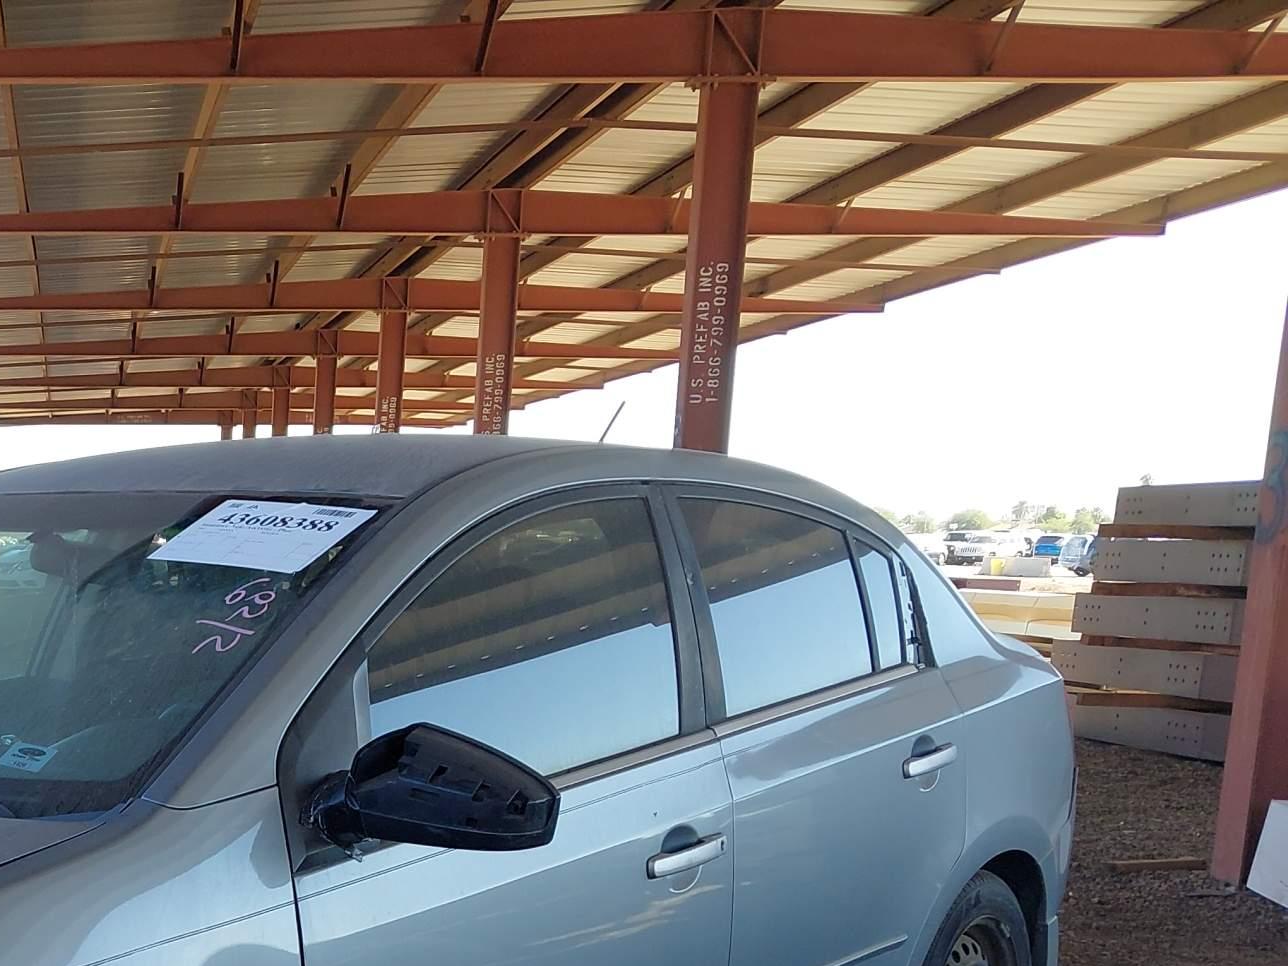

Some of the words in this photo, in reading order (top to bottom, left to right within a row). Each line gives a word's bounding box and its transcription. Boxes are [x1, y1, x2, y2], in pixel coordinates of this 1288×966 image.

[697, 261, 715, 292] INC.
[692, 301, 711, 364] PREFAB
[705, 262, 730, 402] 1-866-799-0969
[485, 353, 496, 374] INC.
[482, 379, 494, 421] PREFAB
[217, 512, 340, 533] 43608388
